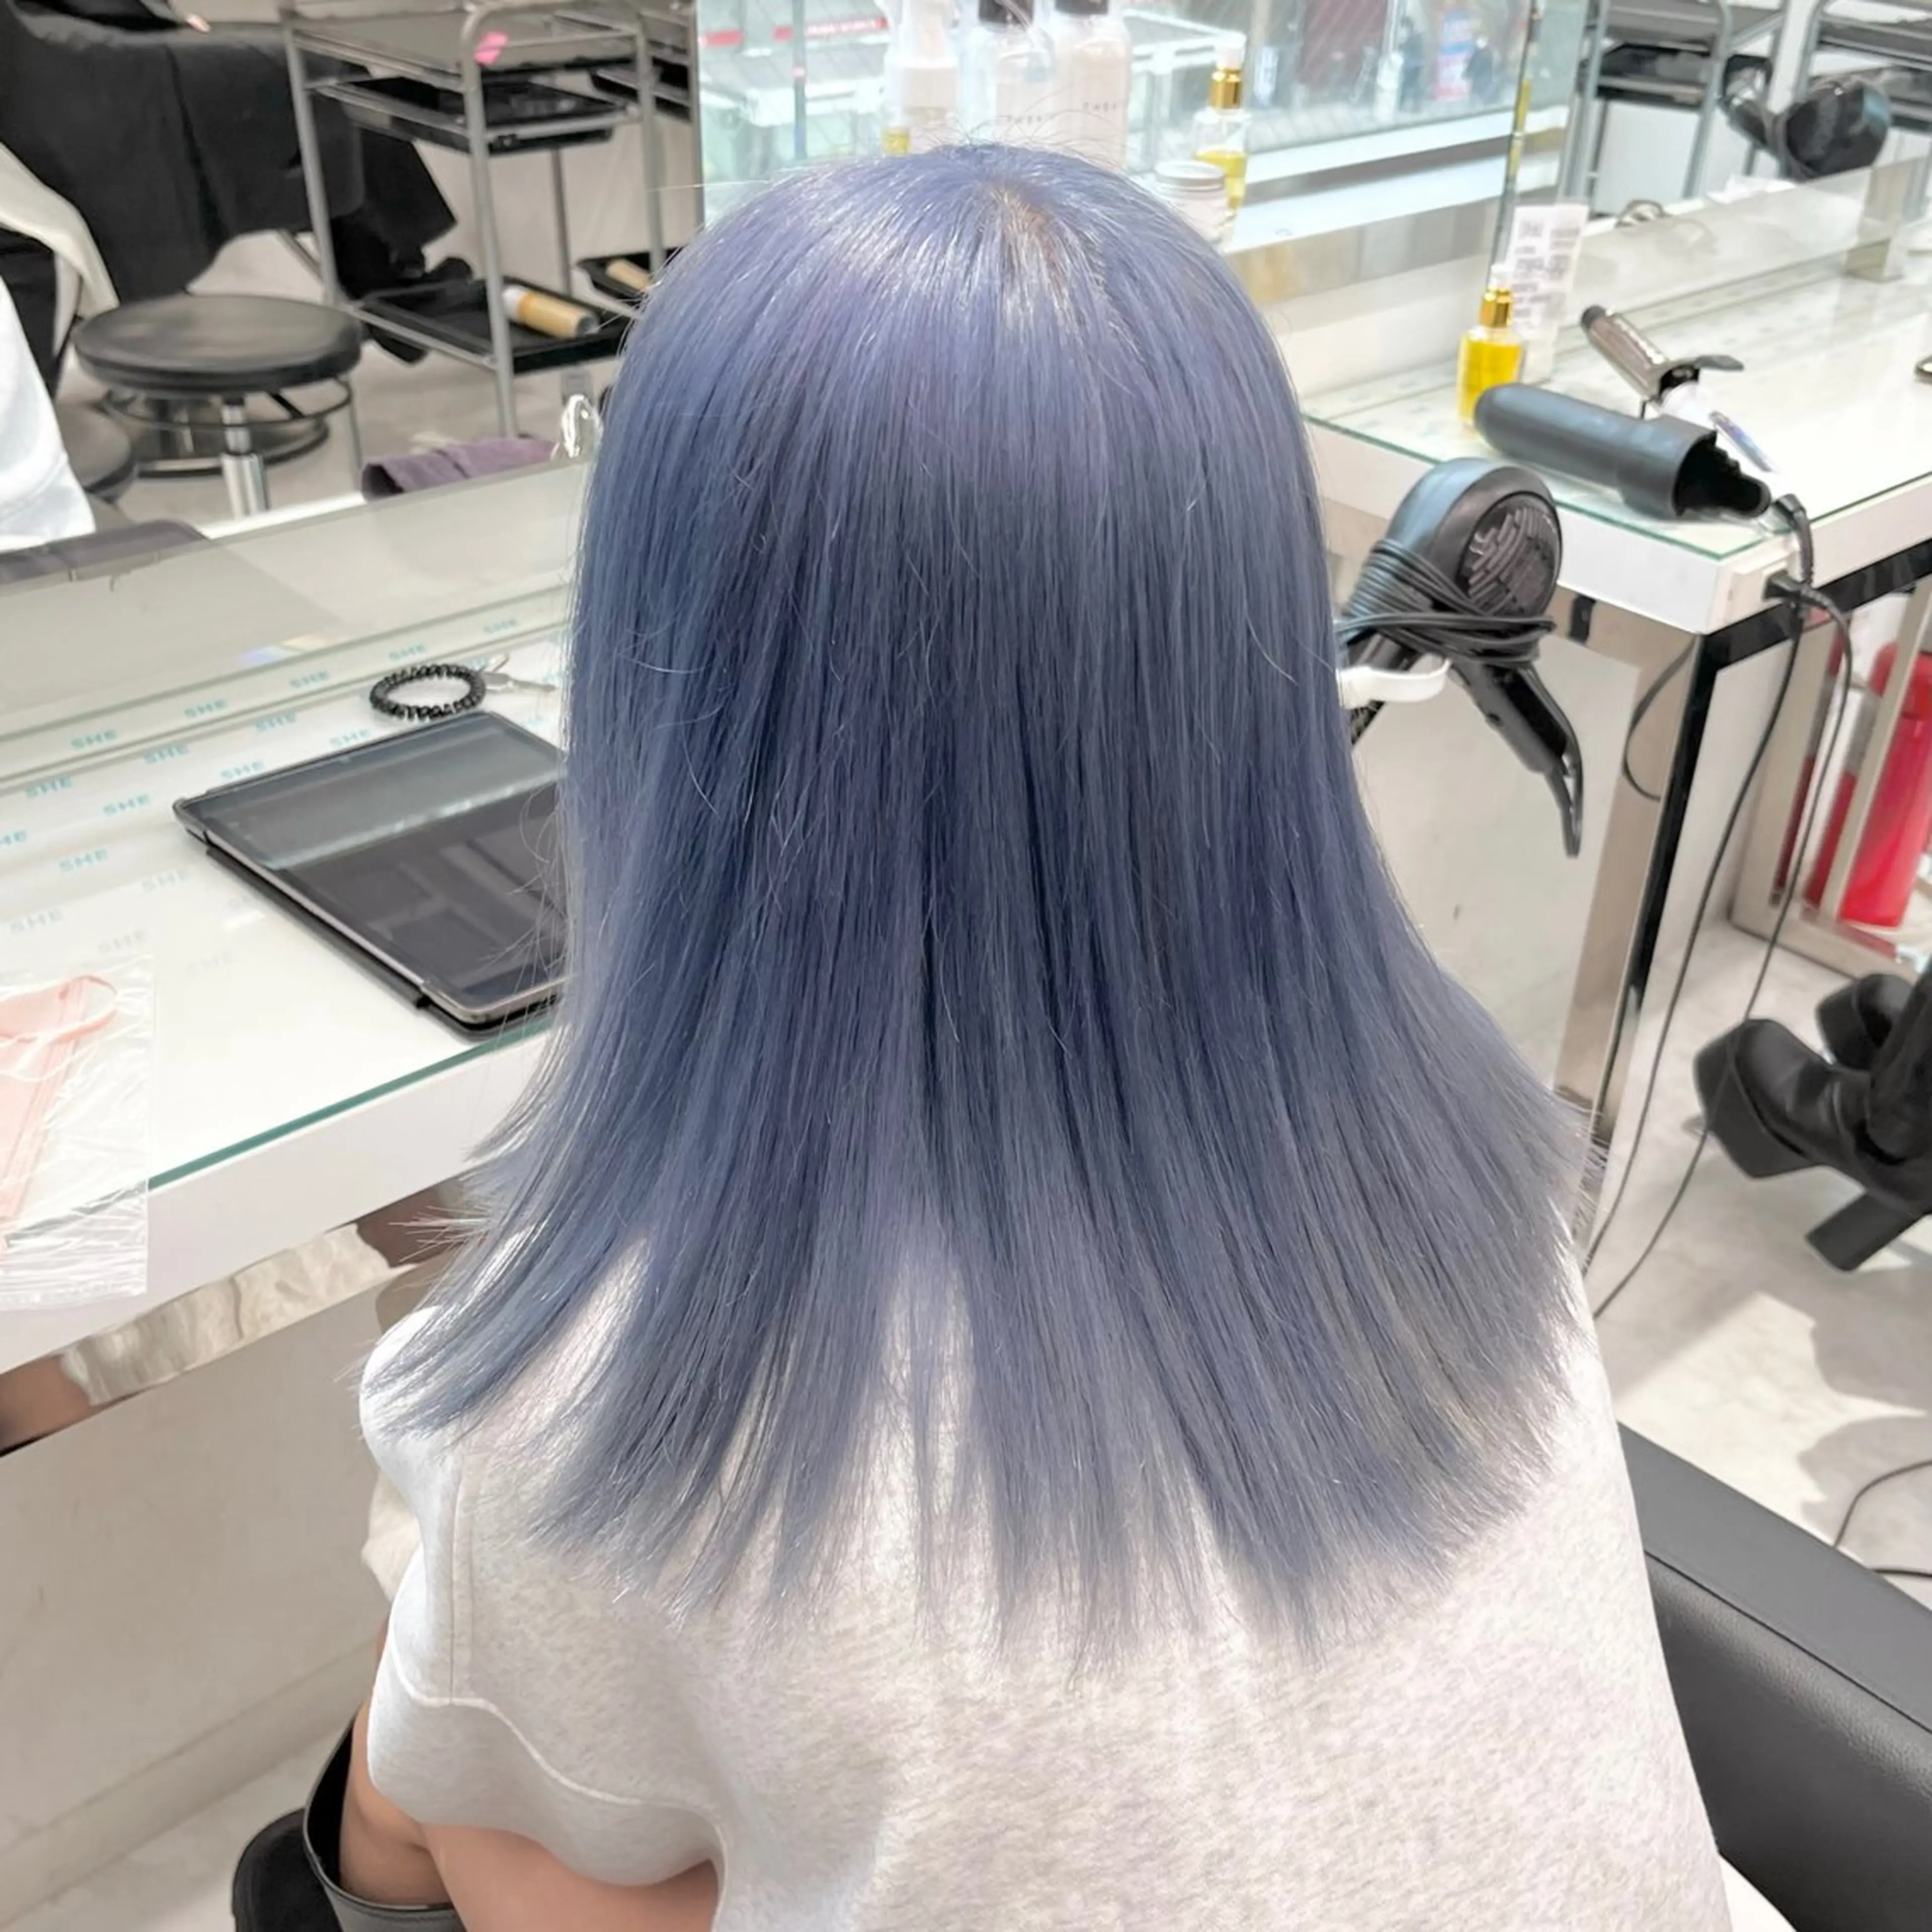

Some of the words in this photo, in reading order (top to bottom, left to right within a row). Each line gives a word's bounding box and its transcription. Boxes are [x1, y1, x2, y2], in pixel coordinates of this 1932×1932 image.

[290, 671, 329, 688] SHE
[184, 698, 226, 717] SHE
[255, 712, 297, 731] SHE
[71, 730, 116, 749] SHE
[144, 744, 190, 763] SHE
[220, 761, 264, 779] SHE
[26, 775, 72, 797] SHE
[104, 793, 150, 815] SHE
[0, 830, 27, 845] HE
[59, 849, 108, 871] SHE
